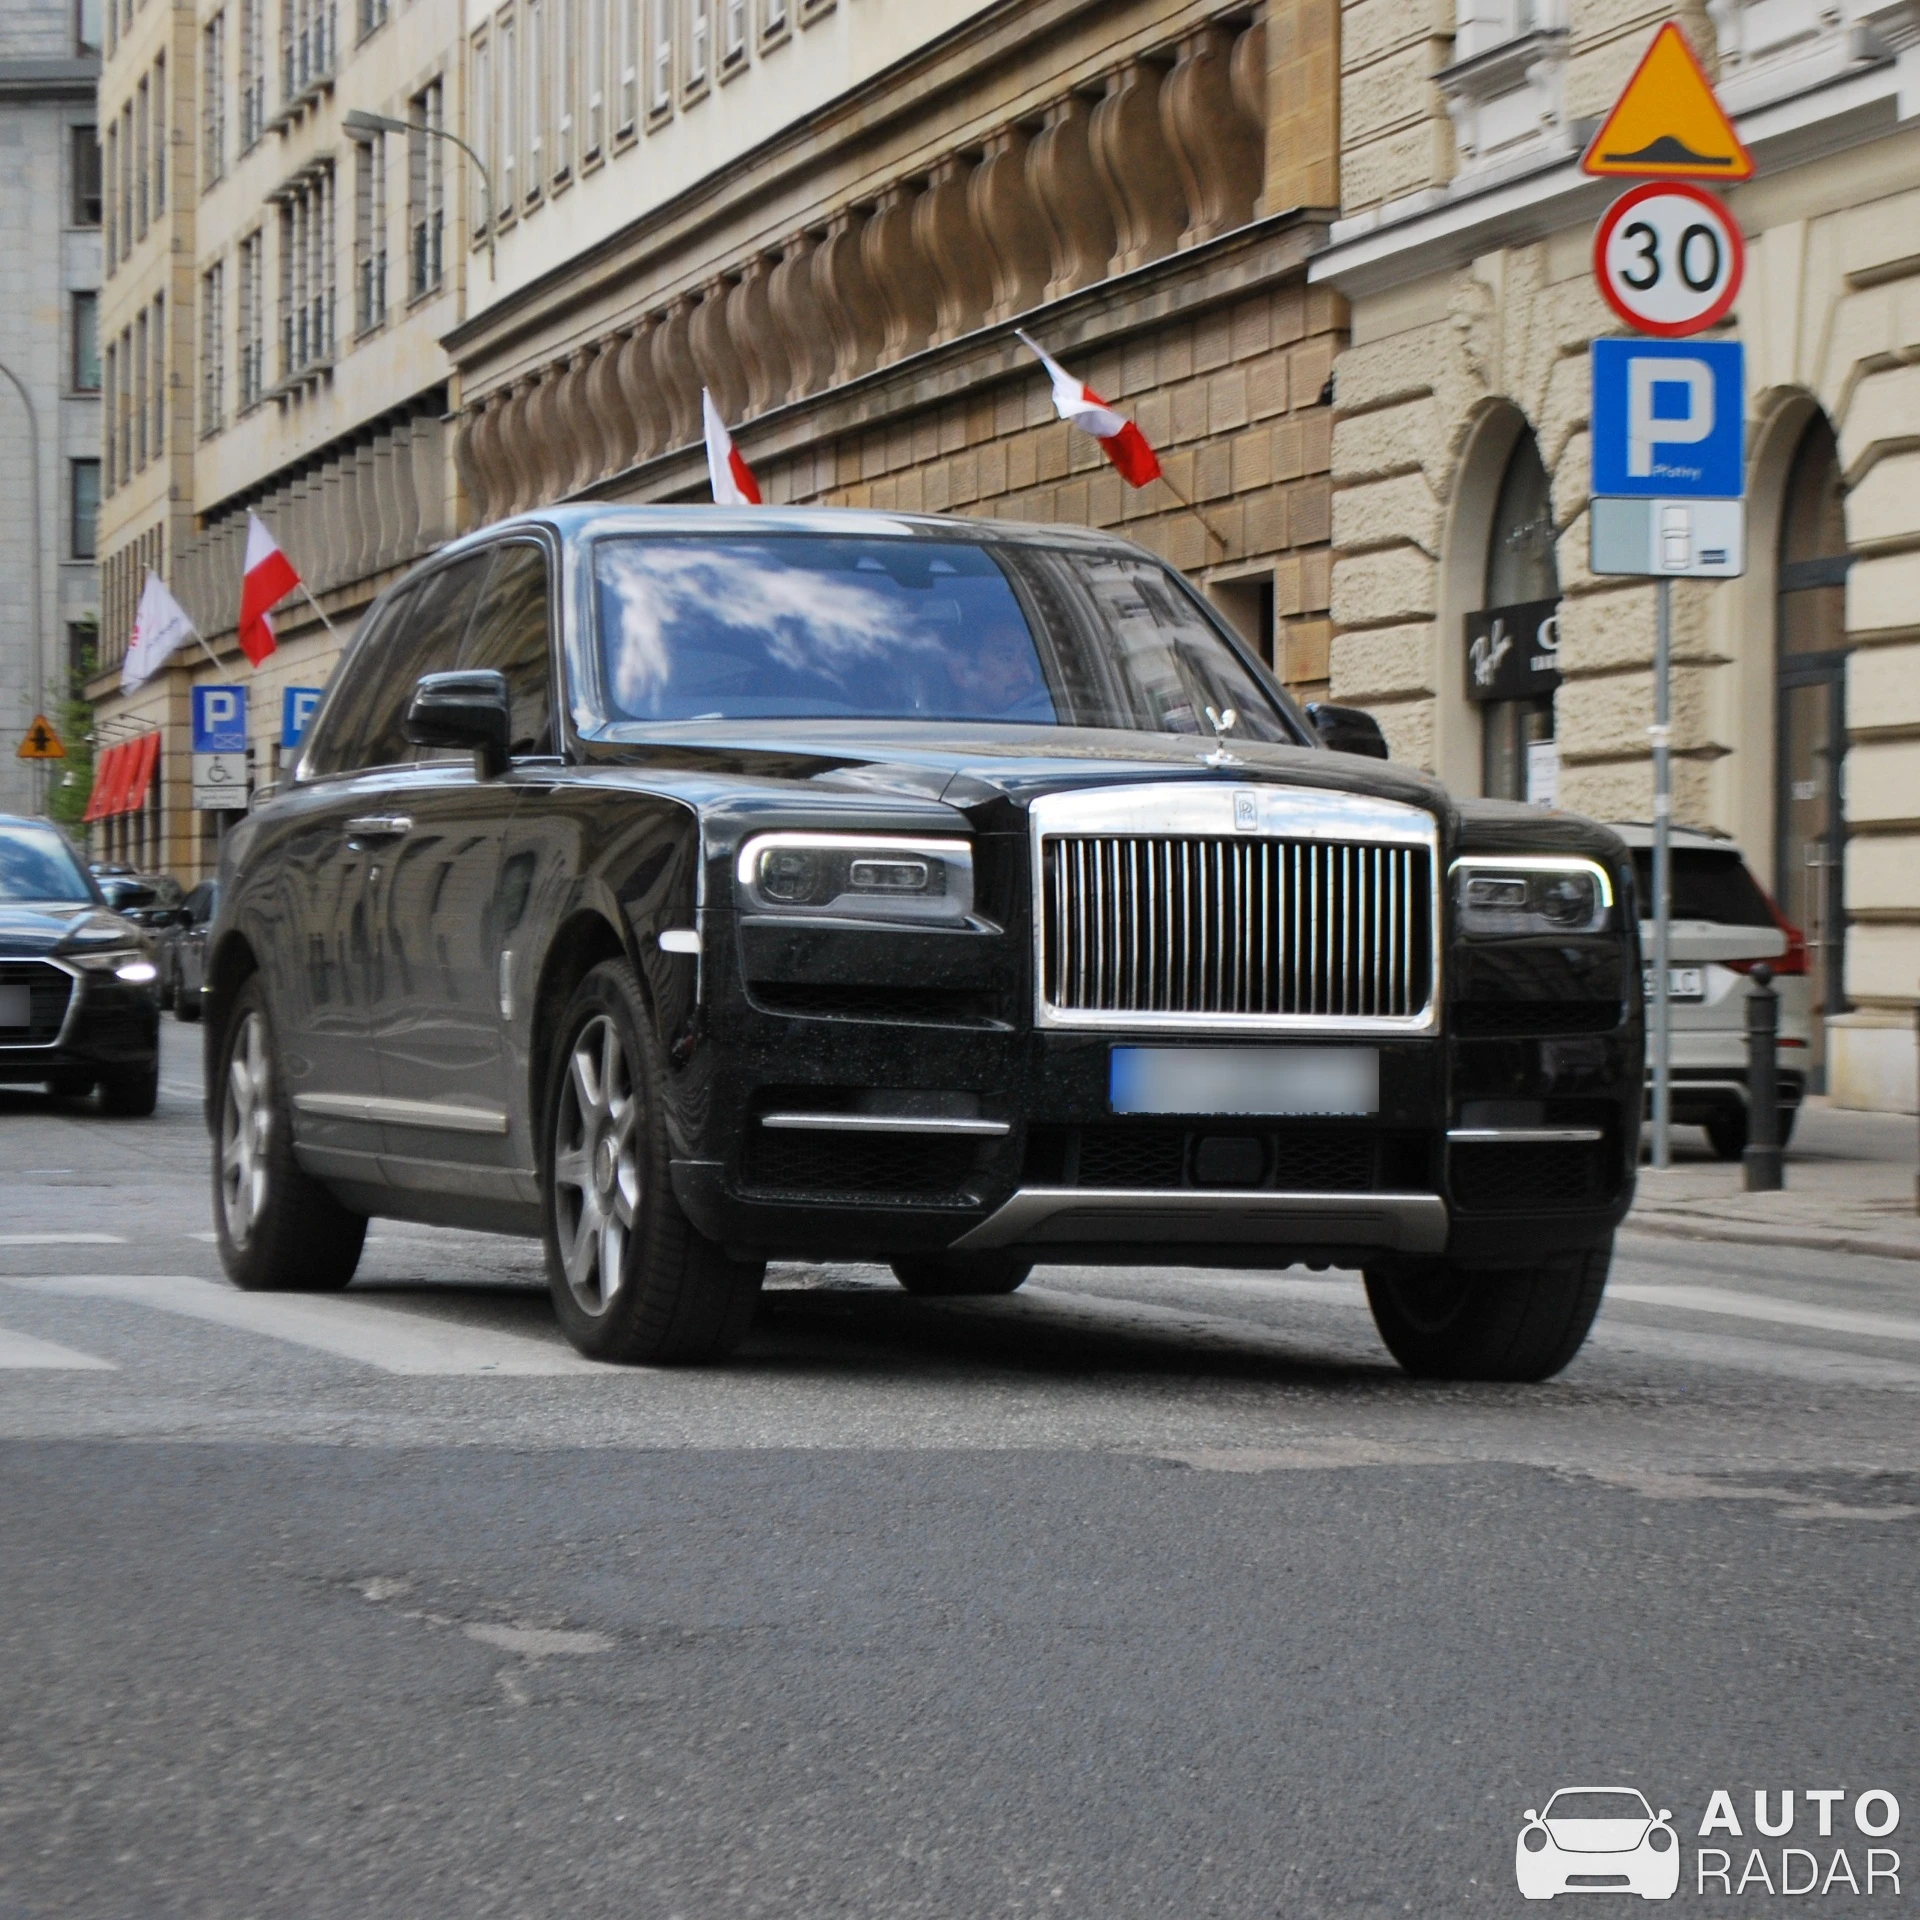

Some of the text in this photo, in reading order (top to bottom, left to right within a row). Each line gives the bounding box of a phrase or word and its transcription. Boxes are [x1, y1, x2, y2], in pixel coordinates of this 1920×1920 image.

[1618, 222, 1720, 293] 30
[1627, 358, 1716, 477] P
[204, 691, 235, 733] P
